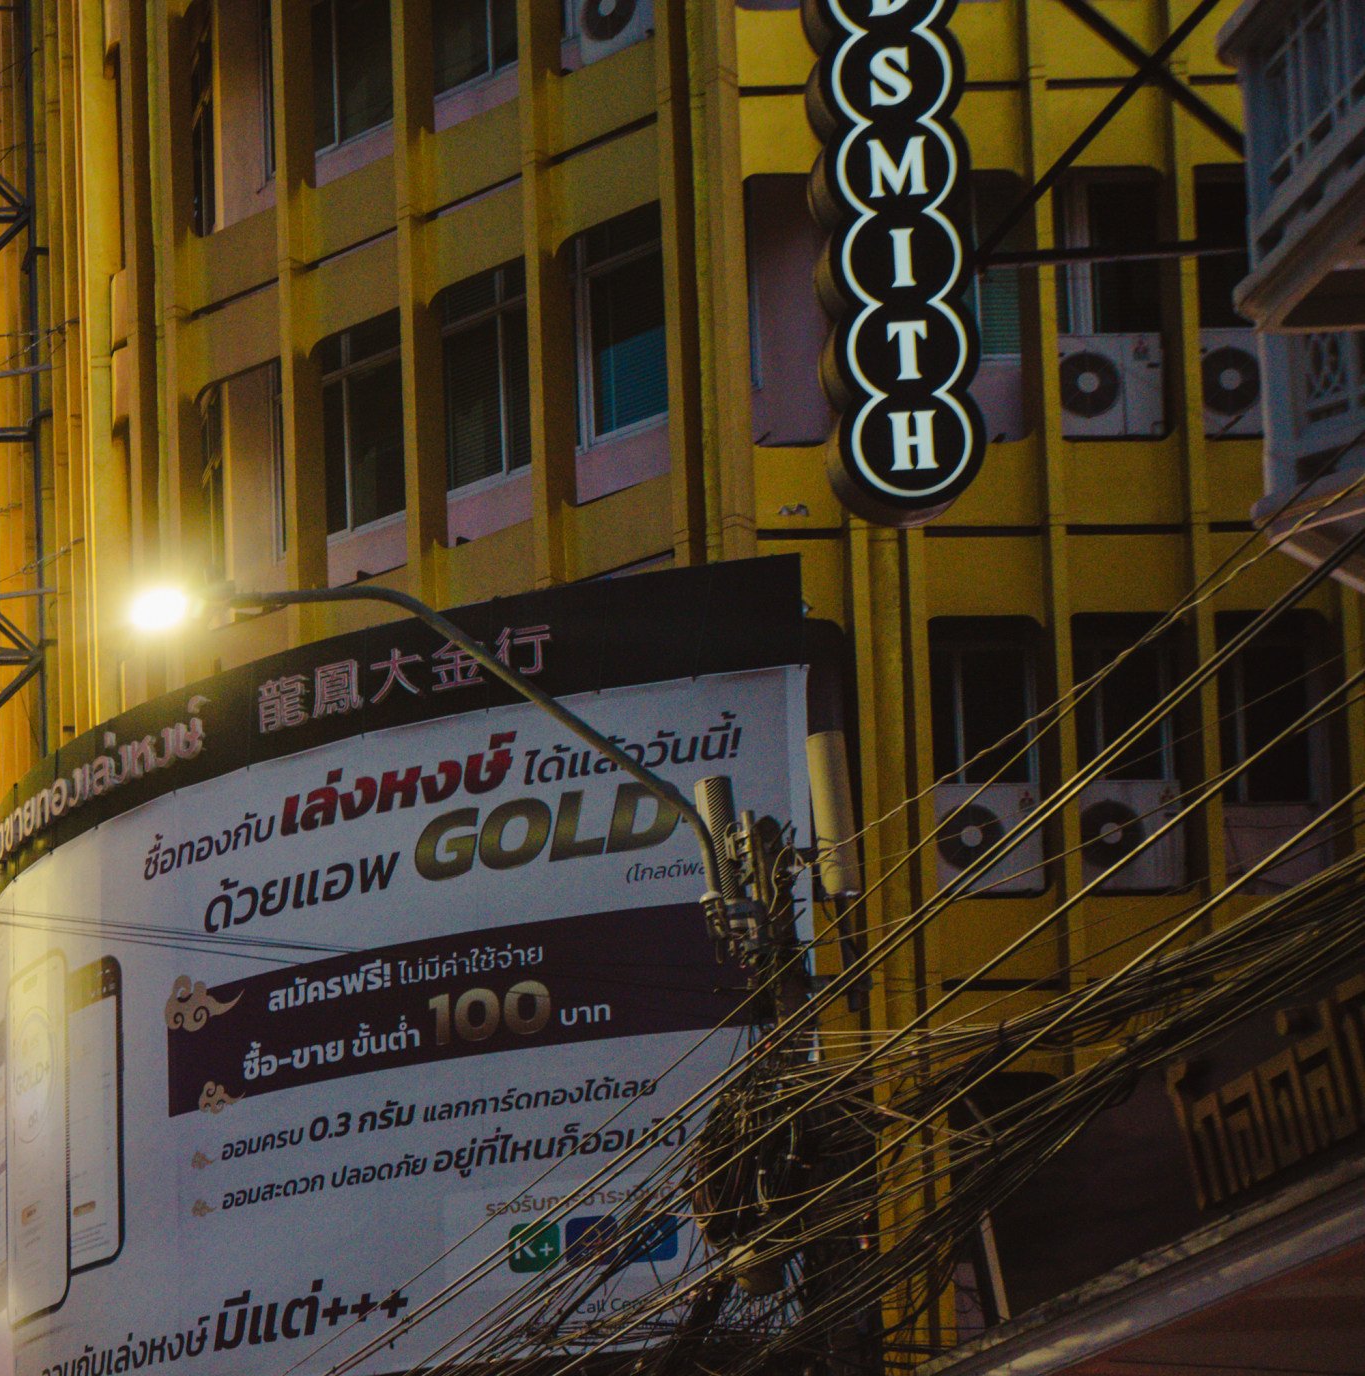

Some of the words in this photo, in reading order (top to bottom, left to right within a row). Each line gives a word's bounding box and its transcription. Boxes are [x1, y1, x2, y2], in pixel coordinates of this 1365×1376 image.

[258, 624, 552, 734] 龍鳳大金行
[144, 811, 274, 880] ซื้อทองกับ
[280, 731, 519, 838] เล่งหงษ์
[204, 852, 400, 934] ด้วยแอพ
[268, 958, 391, 1012] สมัครฟรี!
[398, 942, 544, 985] ไม่มีค่าใช้จ่าย
[243, 1036, 344, 1081] ซื้อ-ขาย
[352, 1015, 421, 1057] ขั้นต่ำ
[429, 979, 552, 1046] 100
[560, 1000, 612, 1026] บาท
[221, 1127, 303, 1161] ออมครบ
[309, 1115, 351, 1142] 0.3
[359, 1098, 415, 1133] กรัม
[422, 1073, 658, 1124] แลกการ์ดทองได้เลย
[221, 1173, 324, 1210] ออมสะดวก
[330, 1154, 428, 1190] ปลอดภัย
[433, 1112, 686, 1179] อยู่ที่ไหนก็ออมได้
